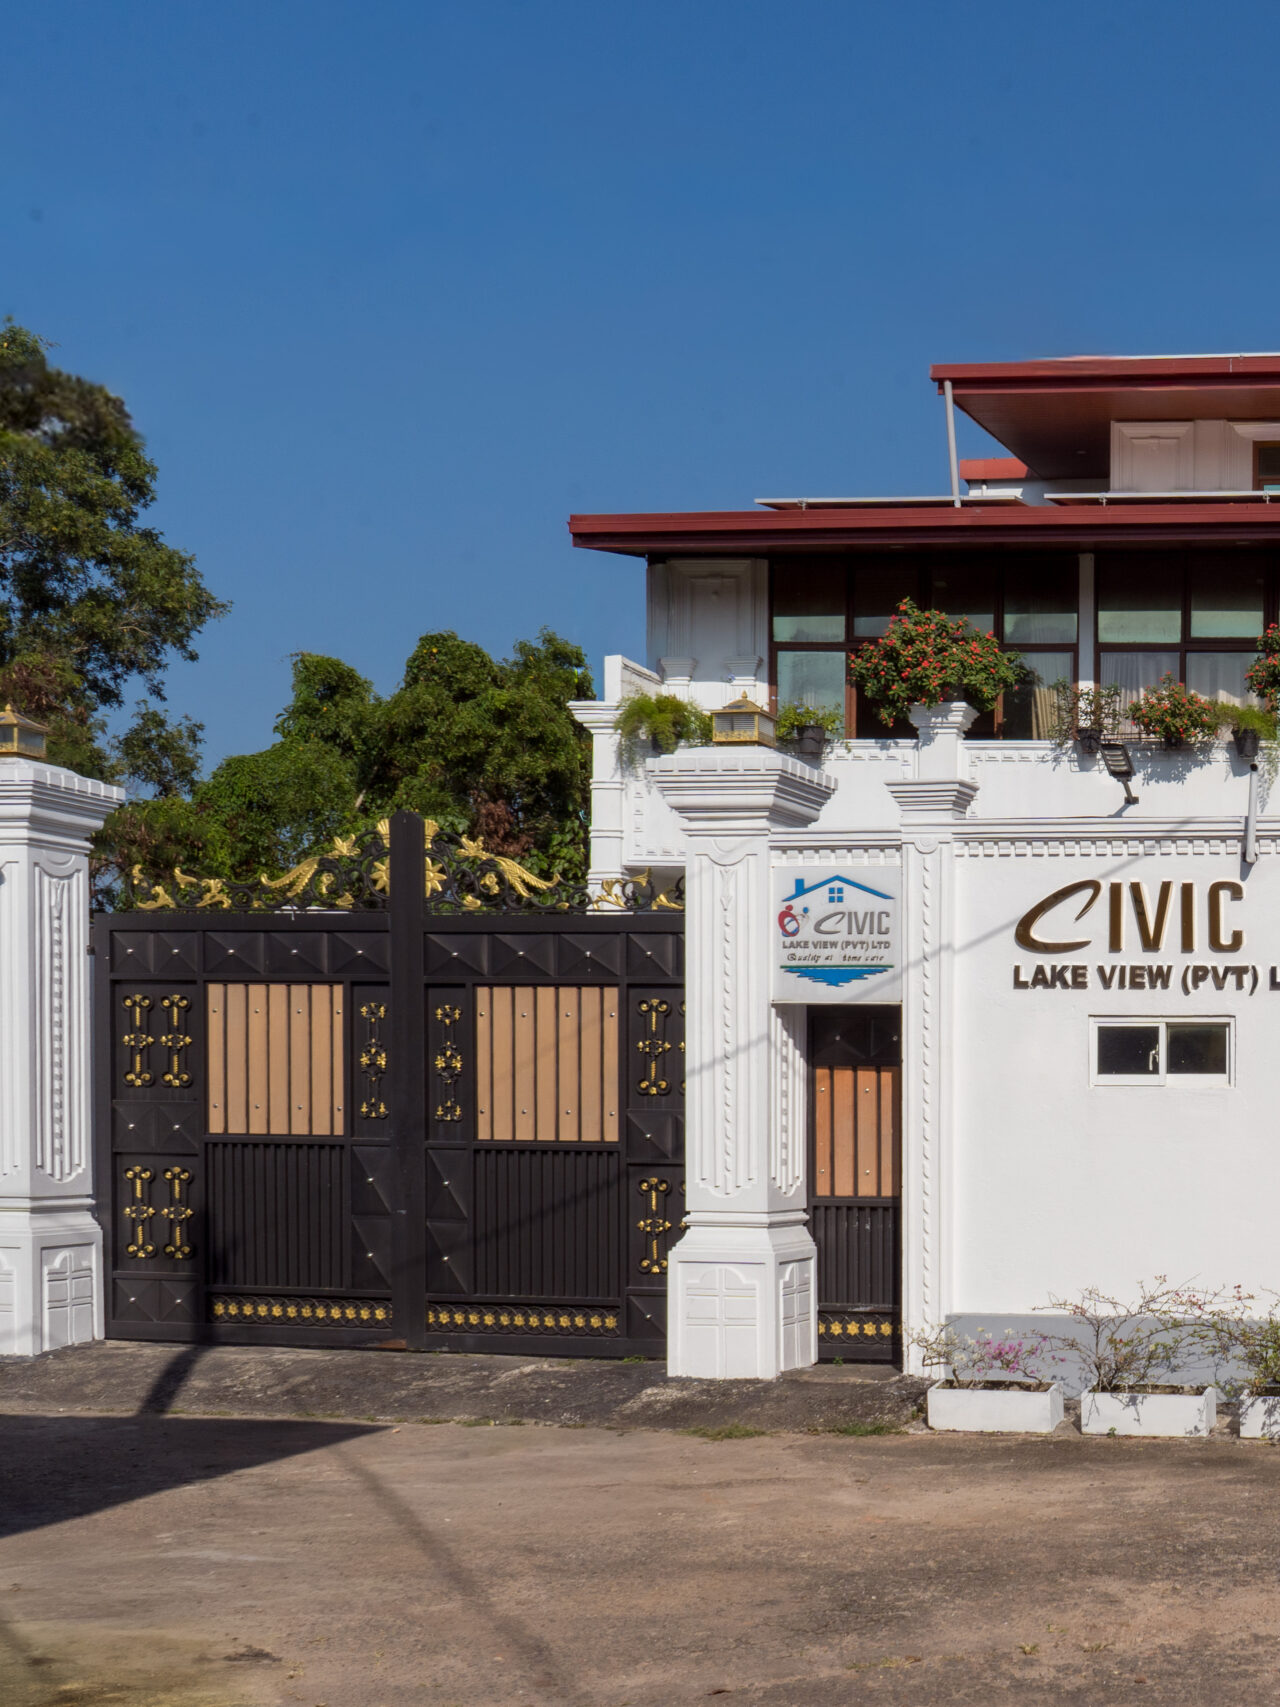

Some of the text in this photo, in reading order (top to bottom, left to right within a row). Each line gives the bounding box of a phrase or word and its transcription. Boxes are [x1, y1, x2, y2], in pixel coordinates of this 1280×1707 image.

[813, 911, 890, 935] CIVIC
[1014, 879, 1245, 953] CIVIC
[782, 940, 891, 951] LAKE VIEW (PVT) LTD
[1013, 965, 1088, 990] LAKE
[1097, 965, 1173, 991] VIEW
[1181, 965, 1259, 996] (PVT)
